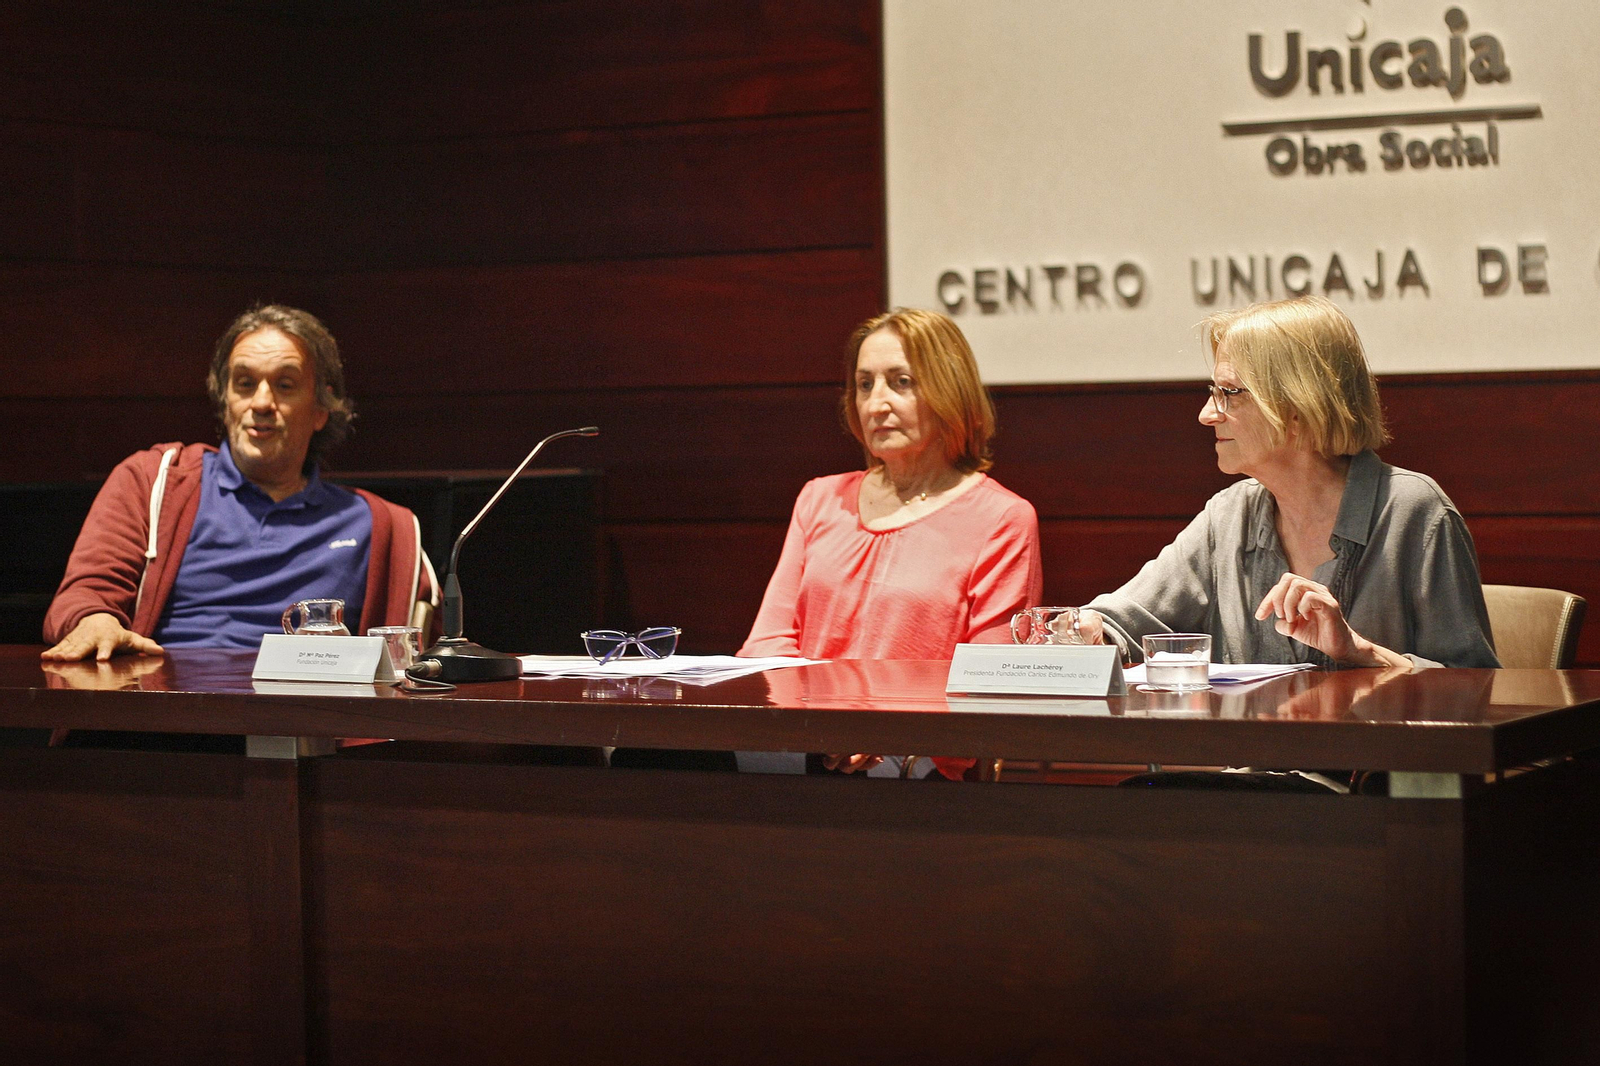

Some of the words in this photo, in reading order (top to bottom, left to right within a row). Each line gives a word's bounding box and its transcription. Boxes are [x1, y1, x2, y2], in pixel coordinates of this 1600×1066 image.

[1247, 7, 1510, 99] Unicaja
[1266, 132, 1366, 175] Obra
[1380, 123, 1500, 170] Social
[938, 261, 1147, 313] CENTRO
[1192, 248, 1430, 304] UNICAJA
[1478, 244, 1550, 295] DE
